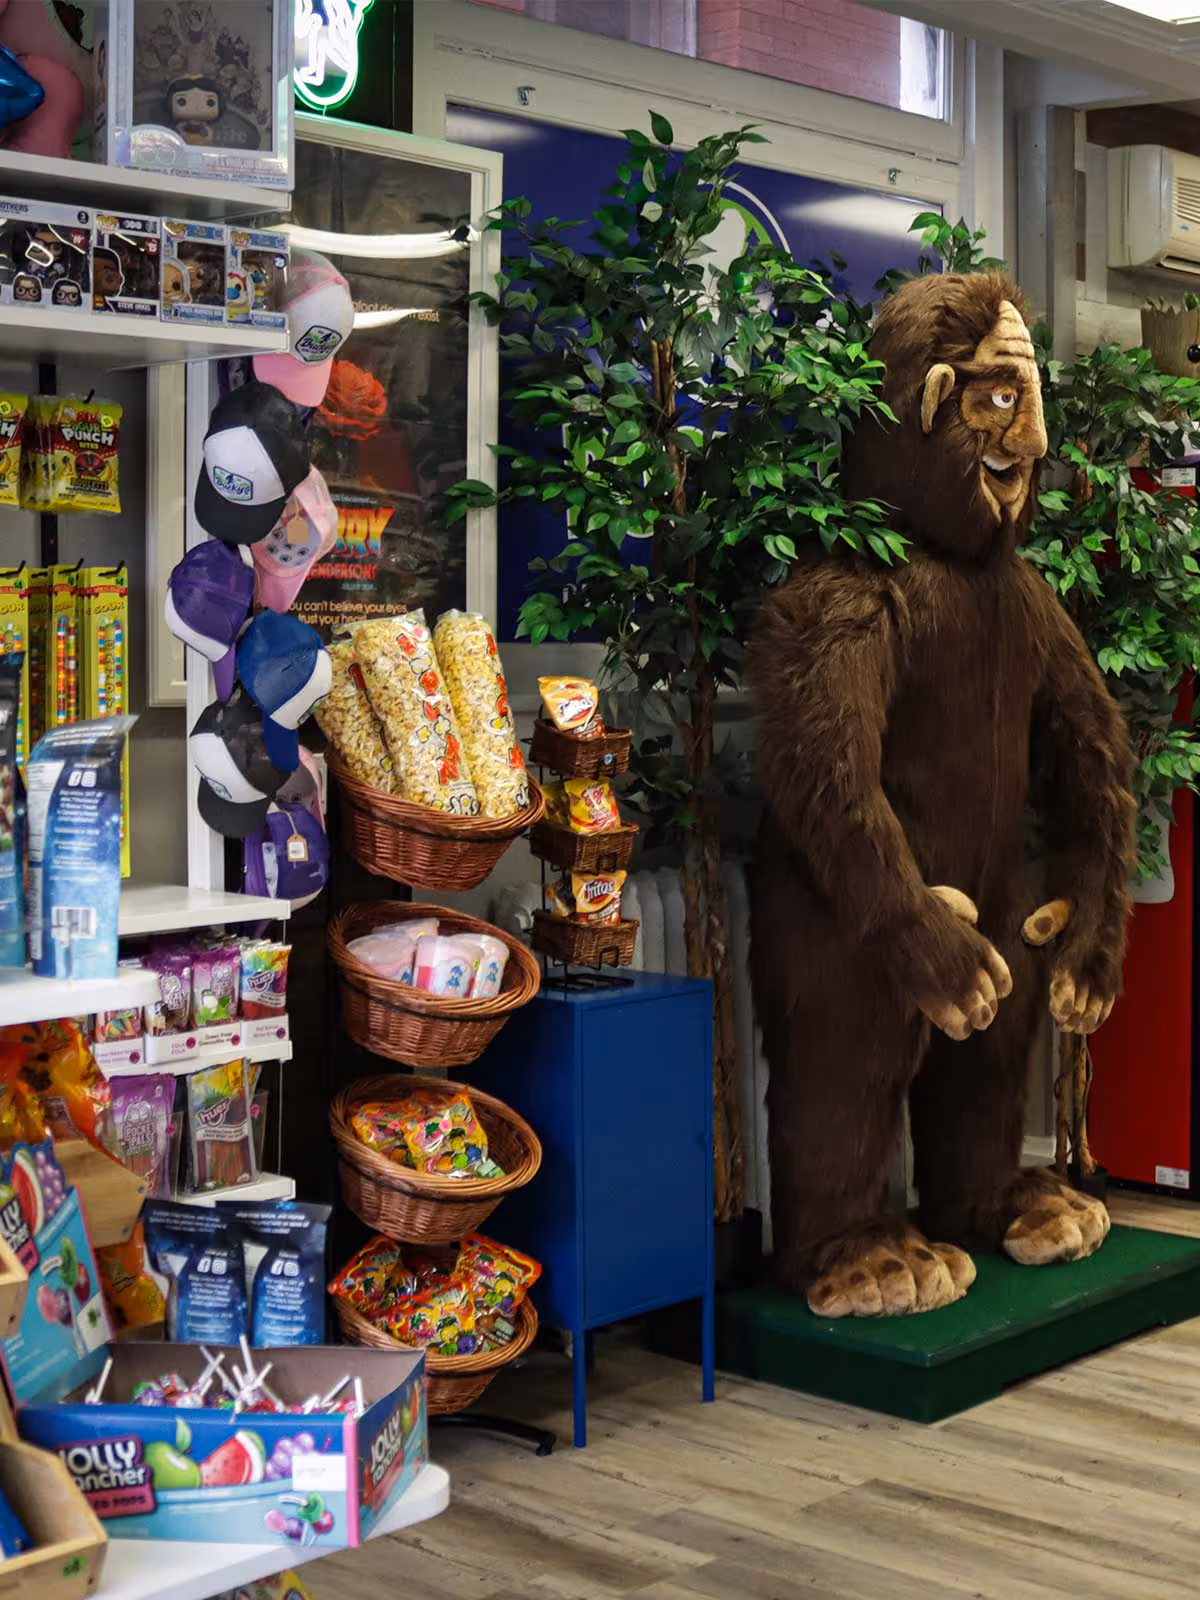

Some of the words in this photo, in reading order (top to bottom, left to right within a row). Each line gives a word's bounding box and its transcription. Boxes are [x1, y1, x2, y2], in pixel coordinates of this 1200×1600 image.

[62, 427, 115, 447] PUNCH
[0, 603, 25, 615] OUR
[94, 601, 125, 615] SOUR
[304, 600, 328, 612] can't
[330, 600, 363, 612] believe
[364, 603, 386, 616] your
[298, 613, 319, 625] trust
[320, 615, 340, 627] your
[370, 1410, 401, 1472] JOLLY
[76, 1467, 147, 1491] ancher
